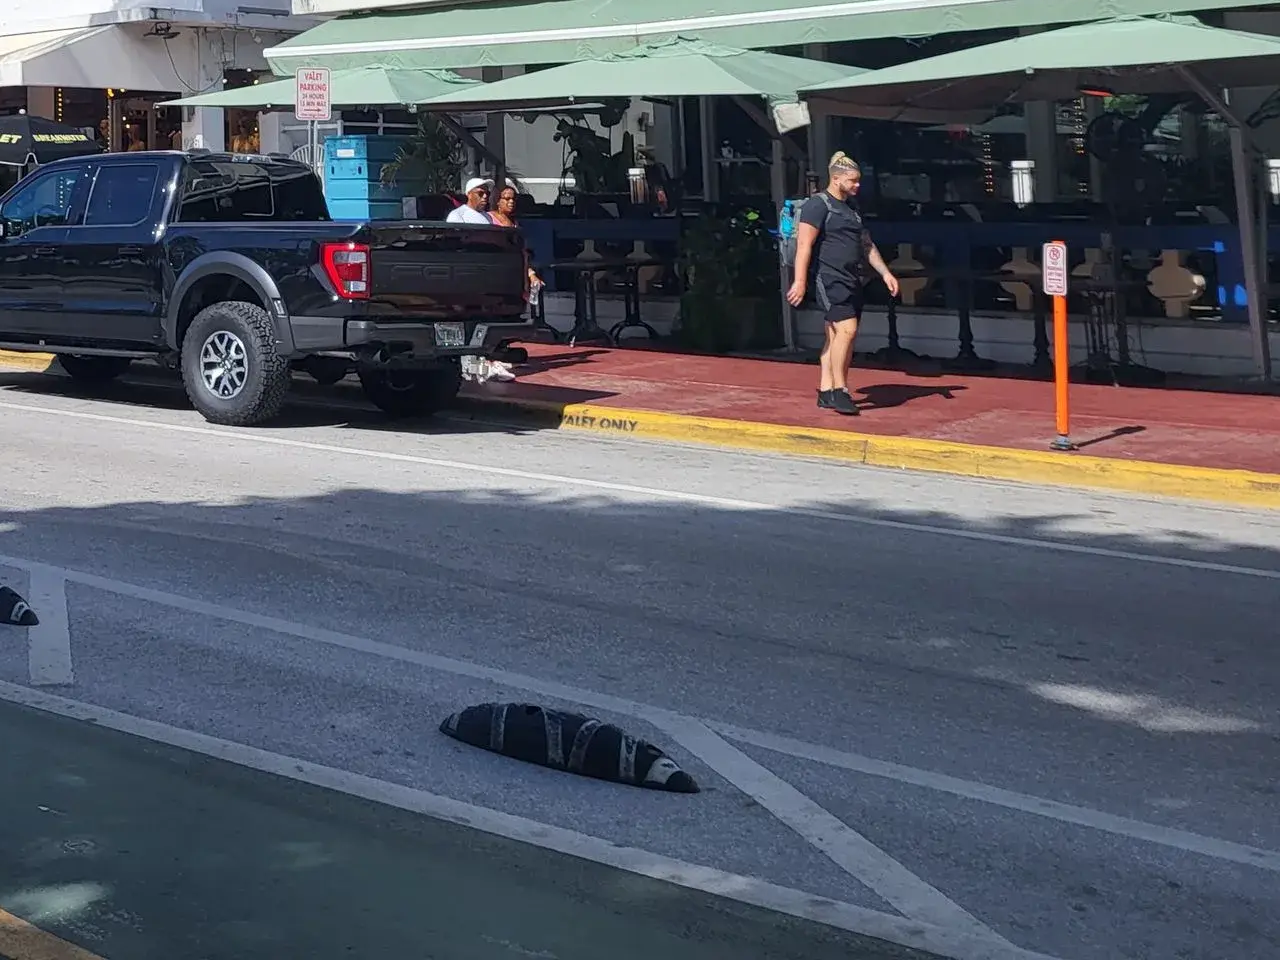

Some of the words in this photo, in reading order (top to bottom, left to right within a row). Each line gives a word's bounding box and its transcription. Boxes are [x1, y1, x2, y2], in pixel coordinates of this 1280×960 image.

[305, 72, 322, 80] VALET
[300, 83, 327, 91] PARKING
[600, 418, 638, 432] ONLY
